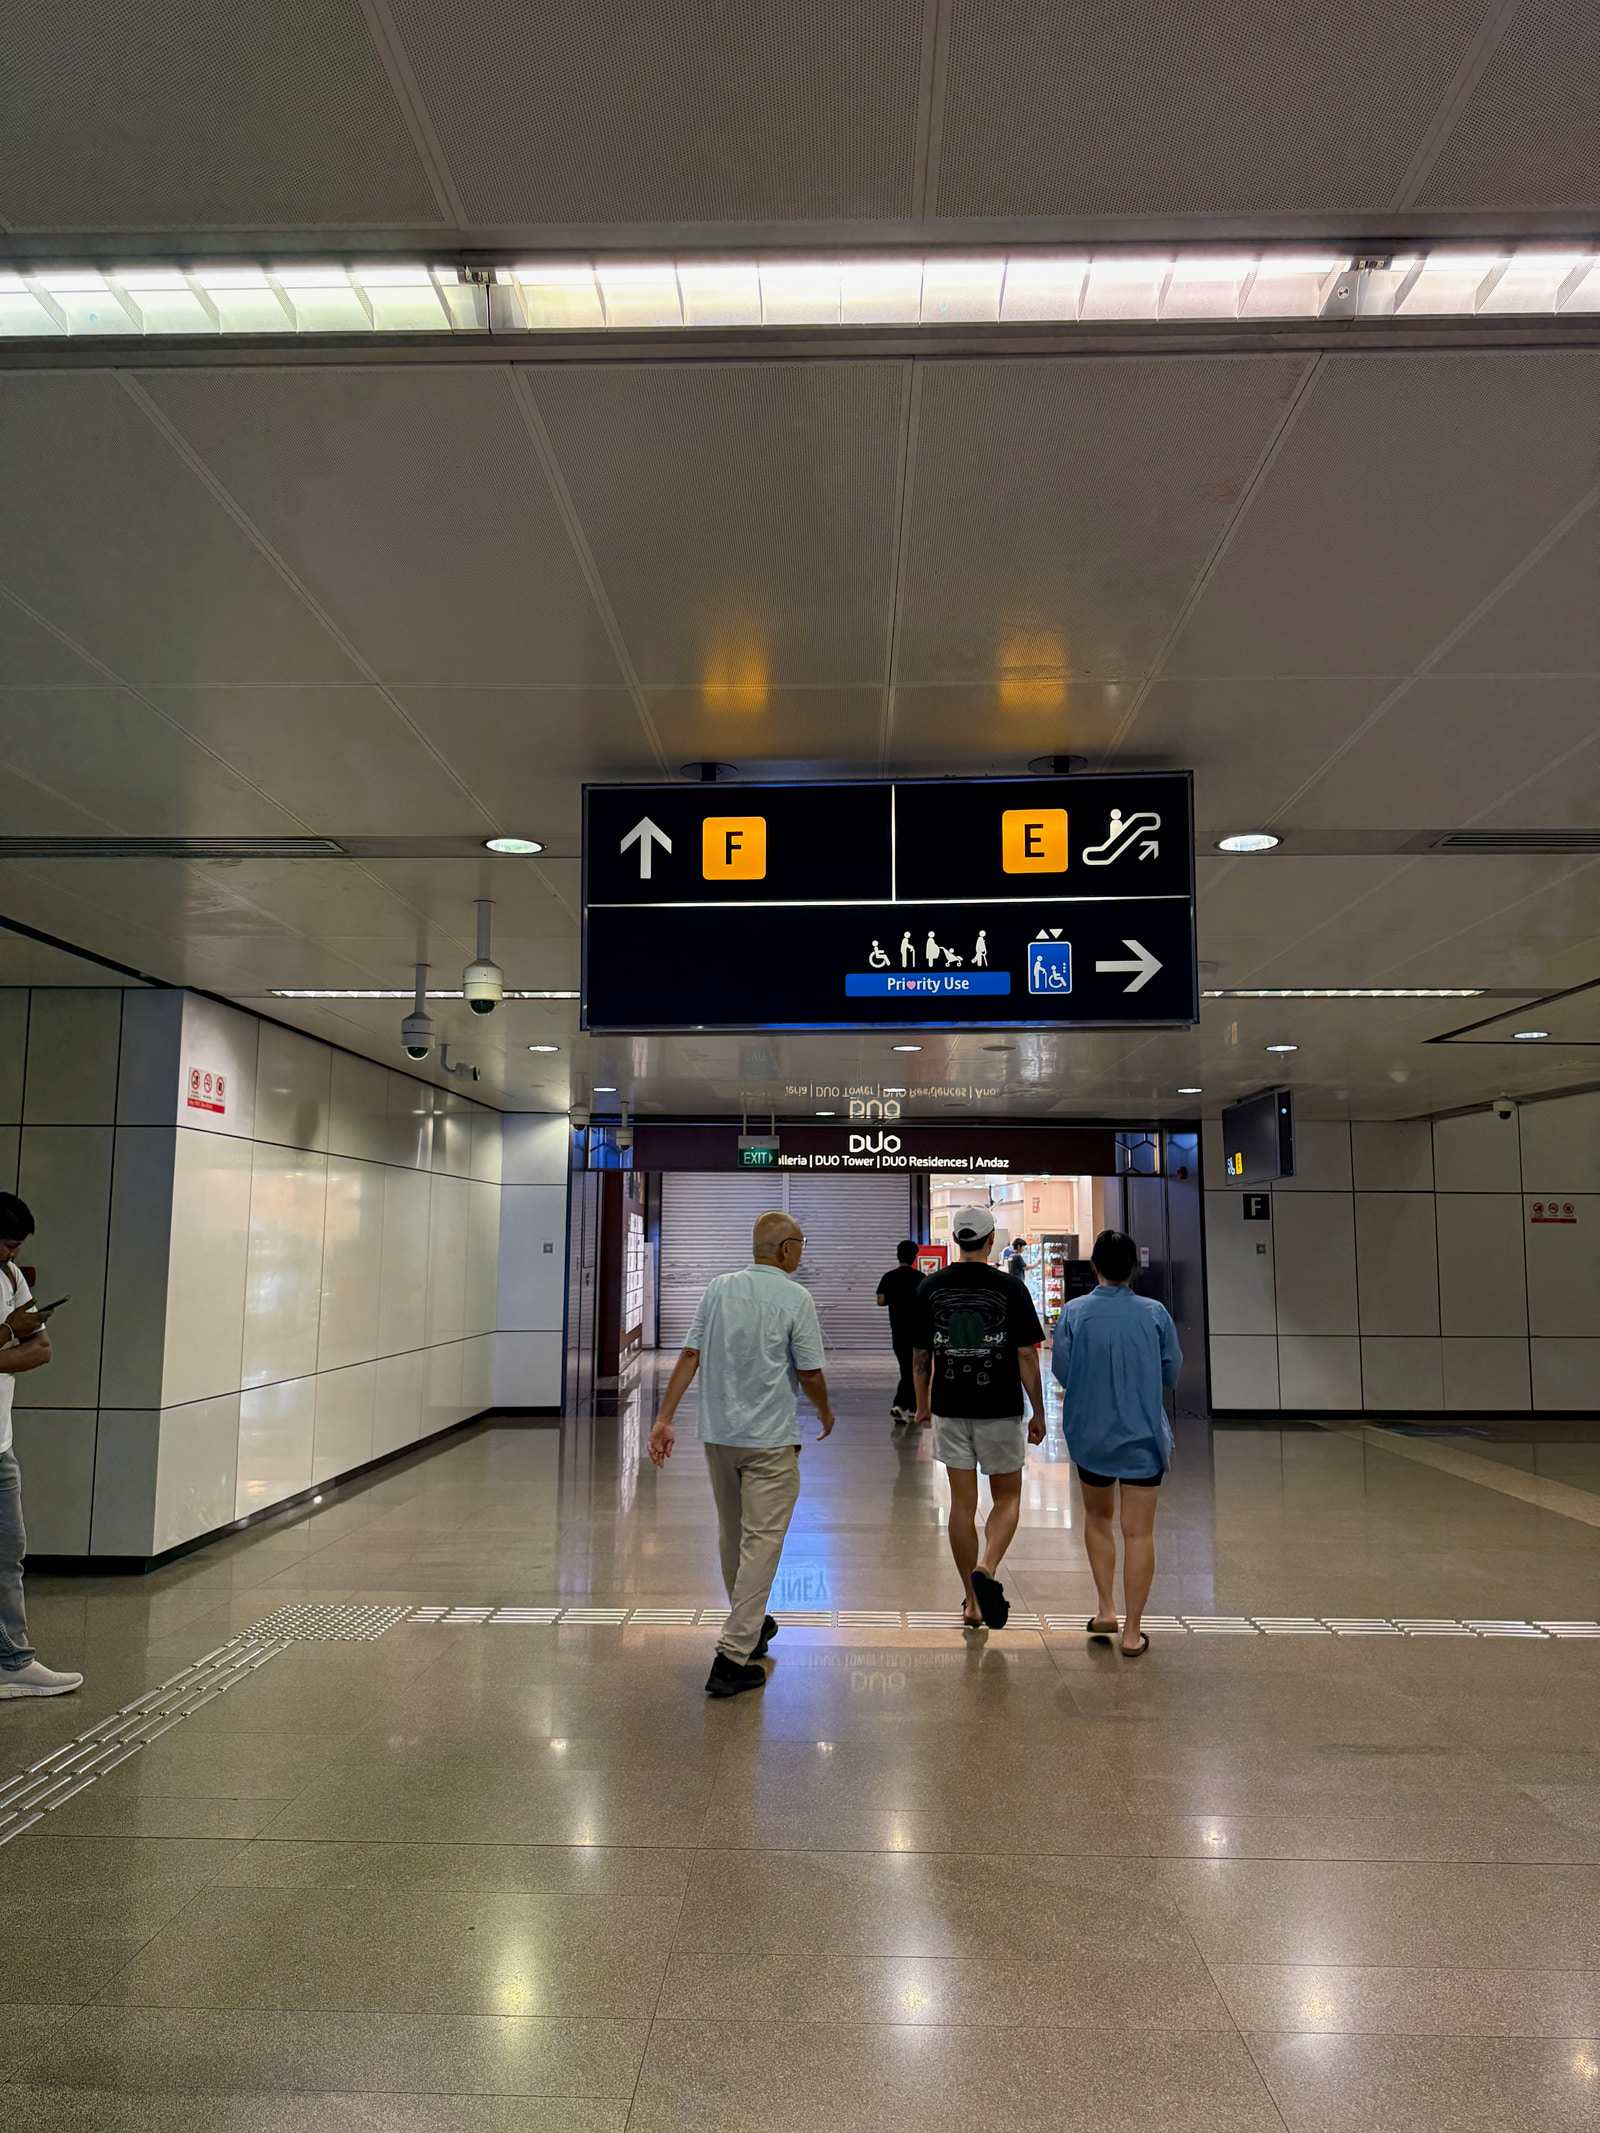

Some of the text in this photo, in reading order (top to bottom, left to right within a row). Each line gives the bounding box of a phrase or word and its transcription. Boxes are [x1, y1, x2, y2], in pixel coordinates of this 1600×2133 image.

[725, 831, 744, 865] F
[1024, 823, 1045, 858] E
[944, 977, 970, 990] Use
[849, 1130, 901, 1153] DUO
[743, 1151, 768, 1165] EXIT
[815, 1155, 840, 1166] DUO
[842, 1155, 875, 1167] Tower
[882, 1155, 907, 1167] DUO
[909, 1156, 968, 1167] Residences
[975, 1156, 1010, 1168] Andaz
[1250, 1197, 1262, 1217] F
